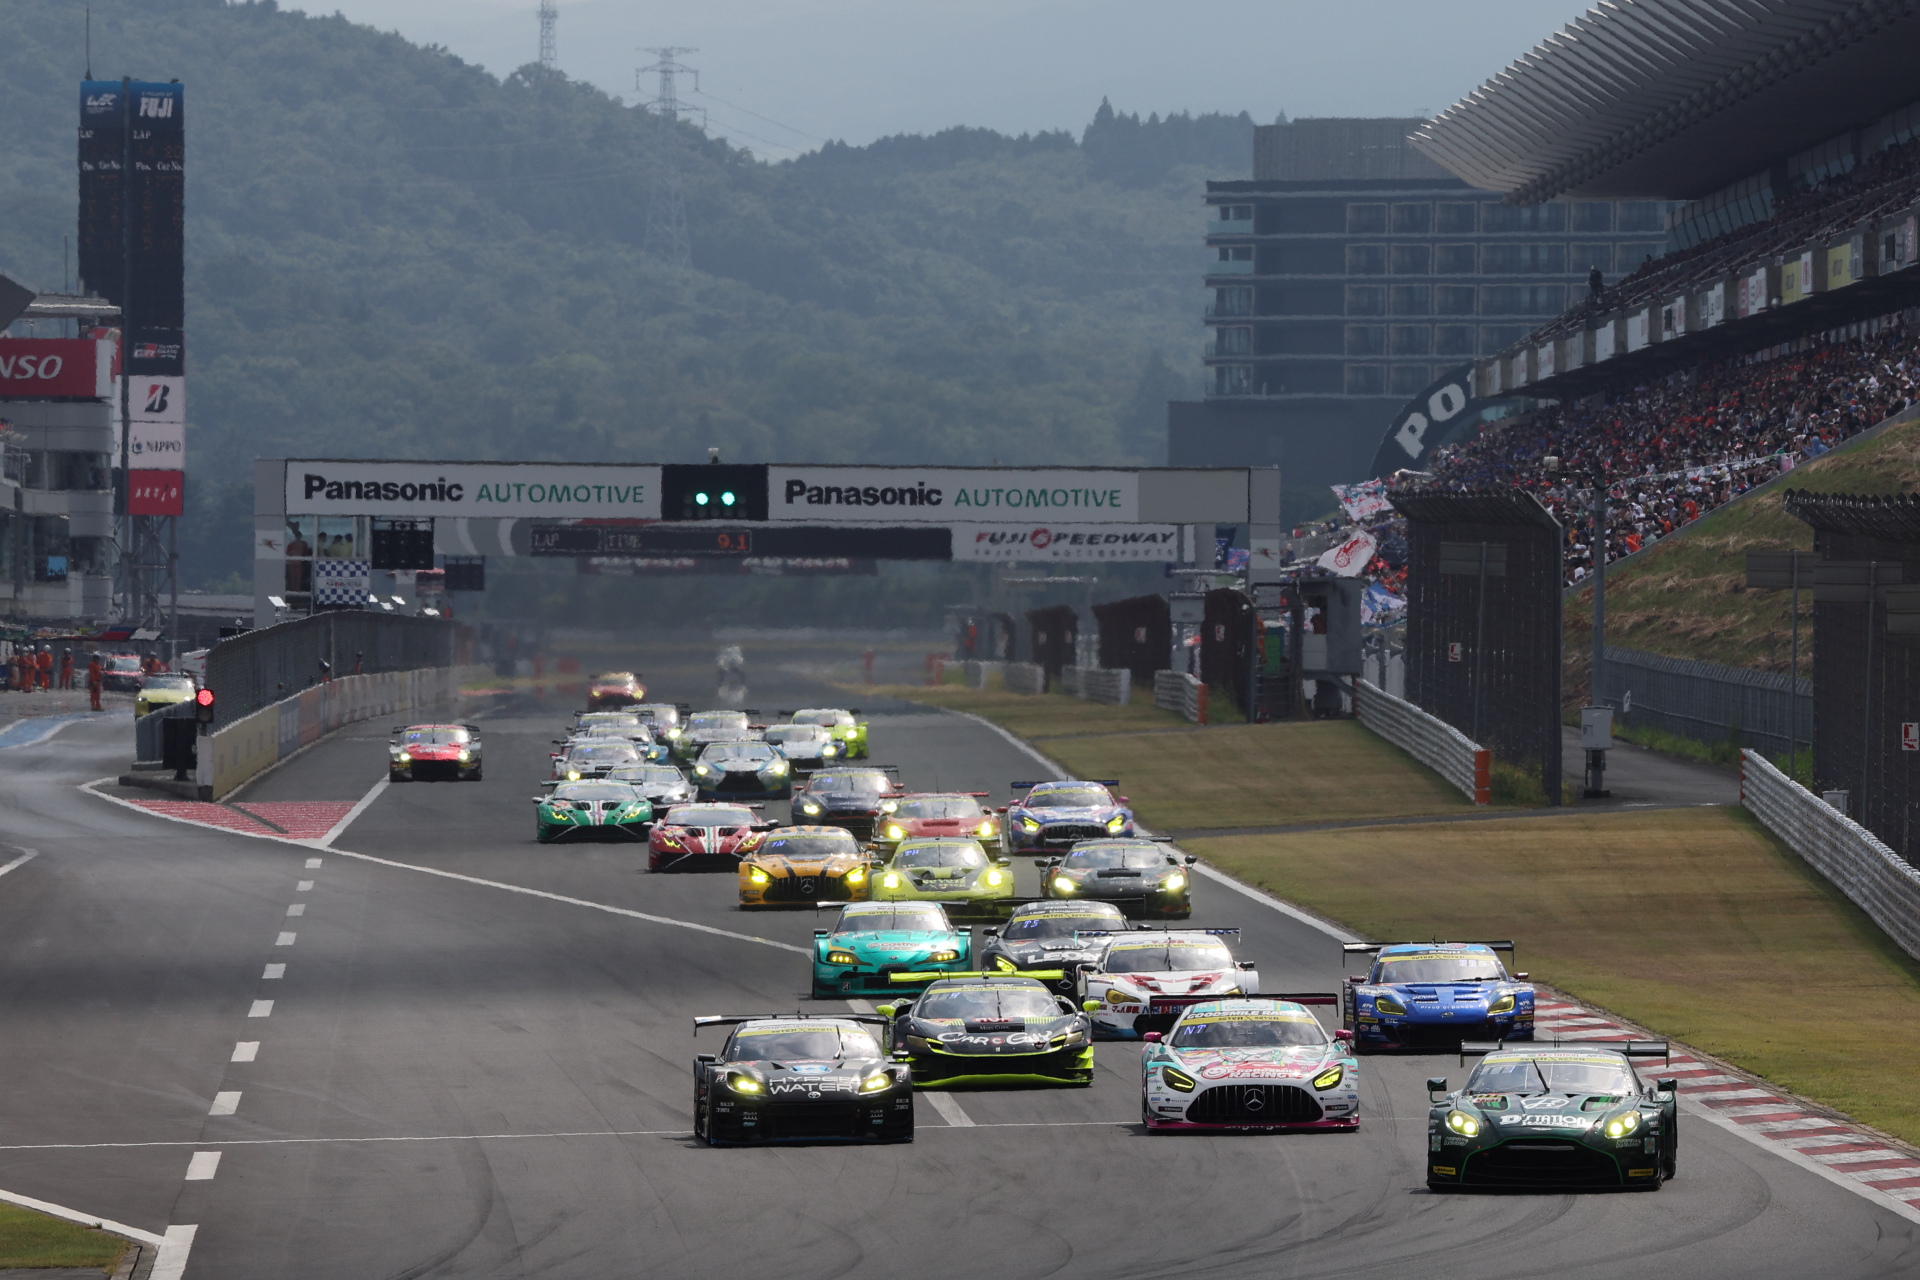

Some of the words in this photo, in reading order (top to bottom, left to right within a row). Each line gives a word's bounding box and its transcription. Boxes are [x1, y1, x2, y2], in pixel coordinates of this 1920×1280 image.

[139, 97, 173, 118] FUJI
[146, 440, 182, 452] NIPPO
[304, 474, 463, 501] Panasonic
[476, 483, 643, 503] AUTOMOTIVE
[785, 479, 942, 506] Panasonic
[954, 488, 1121, 507] AUTOMOTIVE
[716, 533, 747, 550] 9.1
[976, 532, 1026, 544] FUJI
[1028, 951, 1100, 964] LEON
[1187, 1010, 1259, 1019] GOODSMILE
[1183, 1024, 1207, 1035] NT
